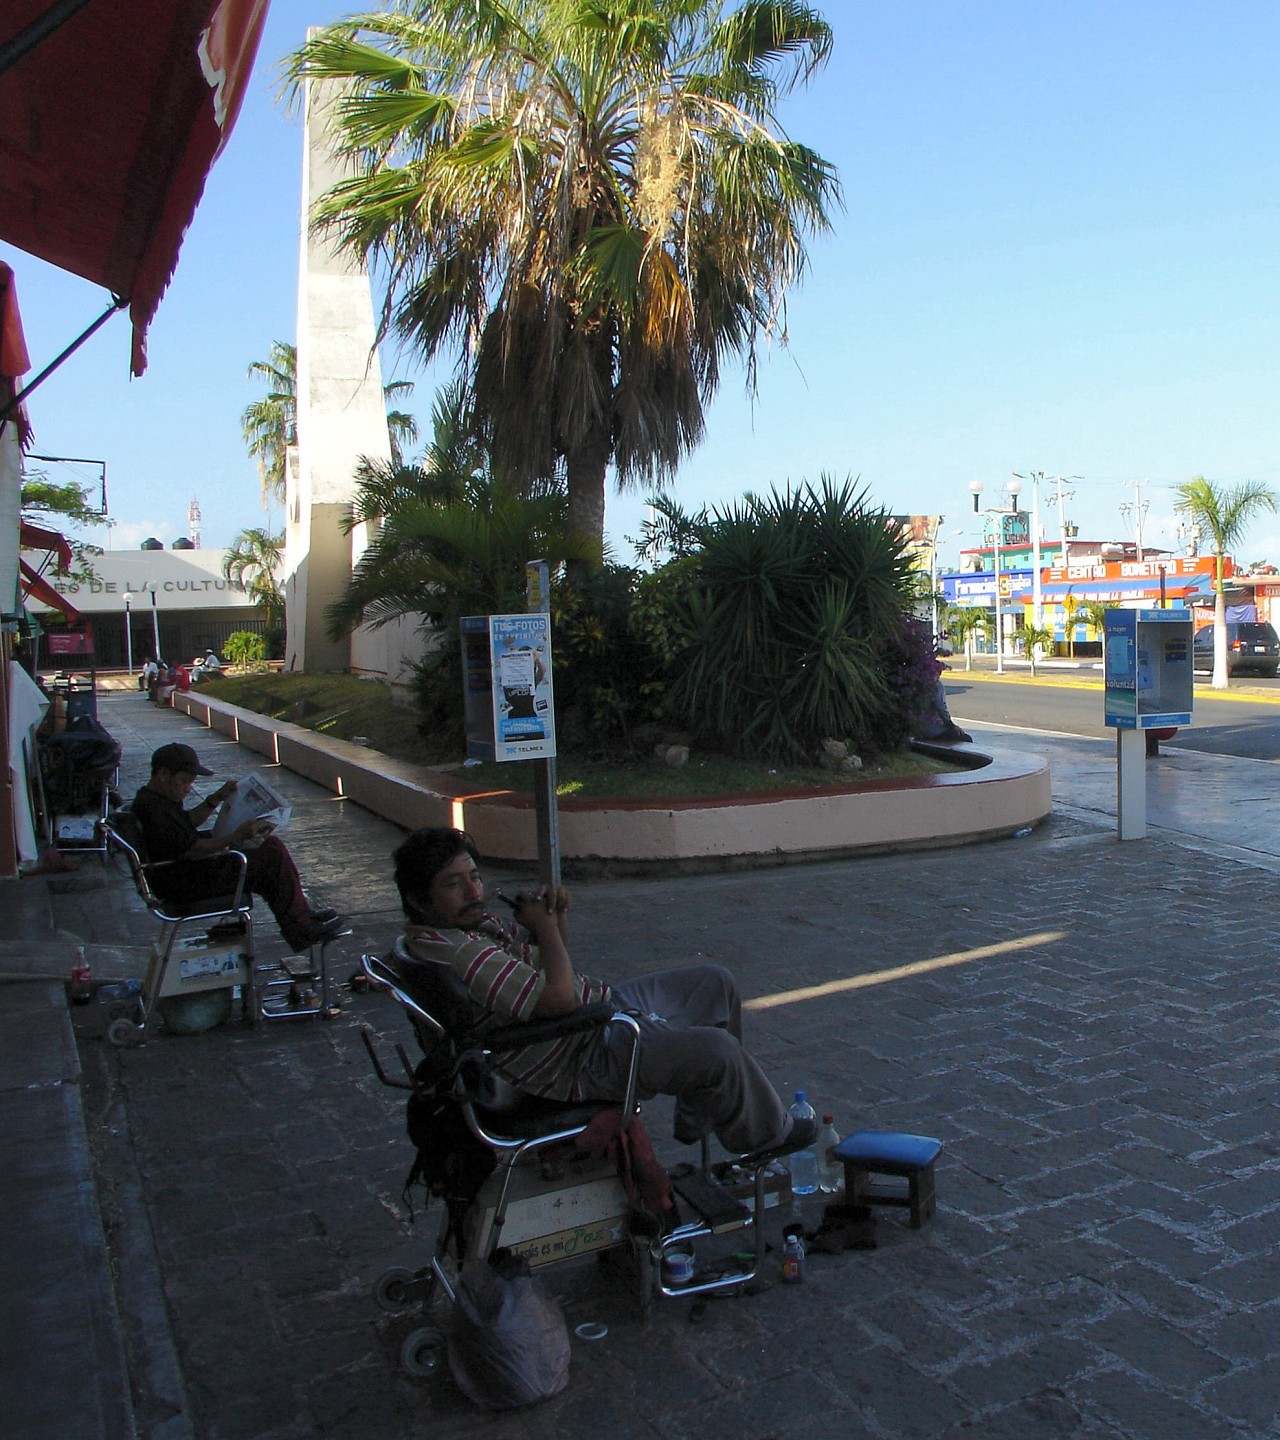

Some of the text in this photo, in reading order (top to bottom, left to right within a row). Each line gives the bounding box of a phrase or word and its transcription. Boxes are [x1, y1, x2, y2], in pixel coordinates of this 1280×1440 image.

[1004, 515, 1027, 533] HOTEL
[90, 581, 117, 593] DE
[516, 620, 546, 631] FOTOS
[542, 1245, 551, 1255] es
